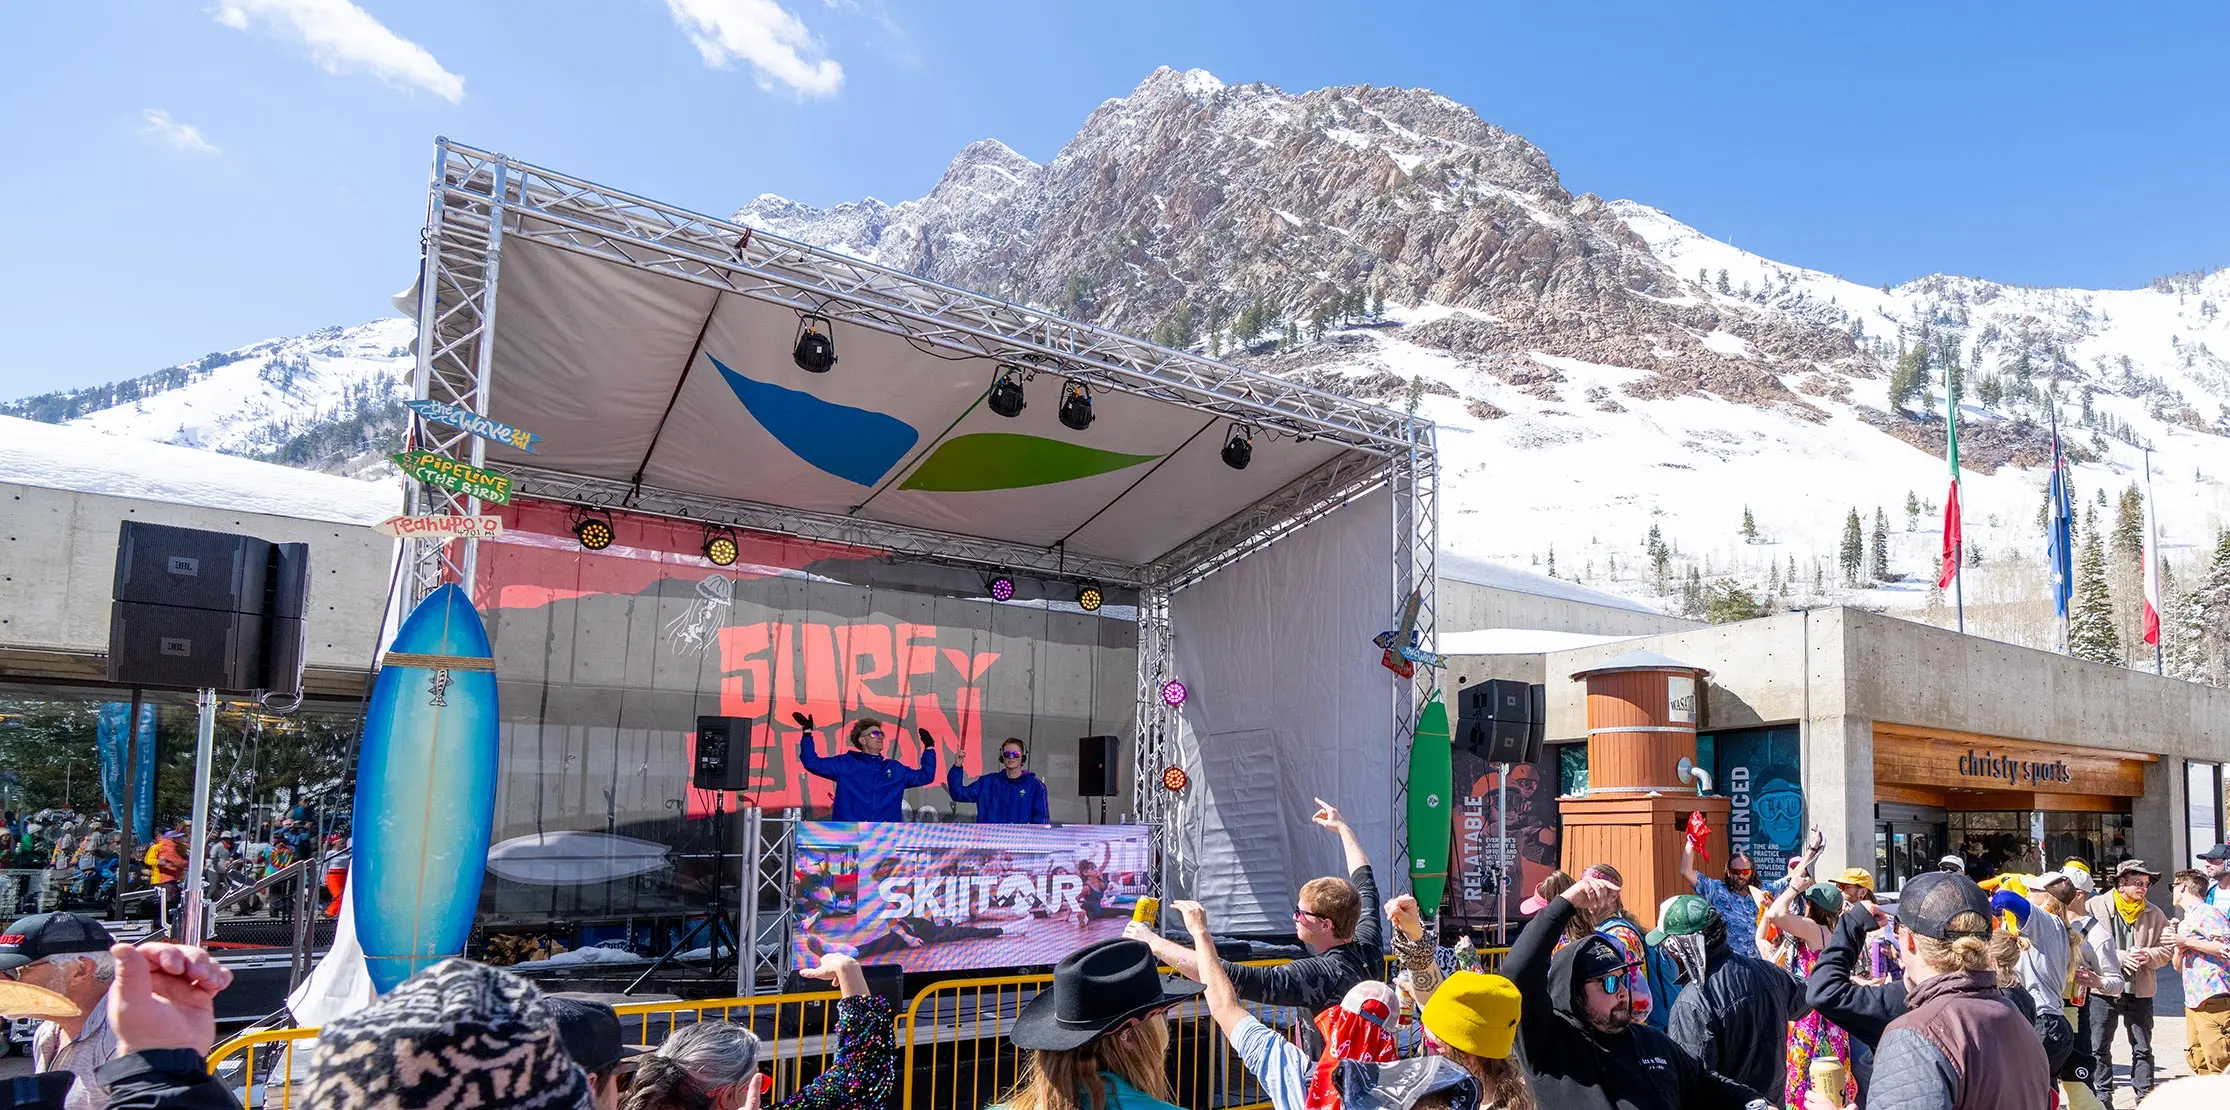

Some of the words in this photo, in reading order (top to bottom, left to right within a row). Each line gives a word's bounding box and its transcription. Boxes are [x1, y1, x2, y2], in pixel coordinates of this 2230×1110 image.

[431, 400, 452, 414] the
[175, 560, 193, 571] JBL
[167, 642, 186, 652] JBL
[1960, 748, 2018, 785] christy
[2023, 759, 2072, 787] sports
[1731, 766, 1750, 855] RIENCED
[1463, 796, 1482, 900] RELATABLE
